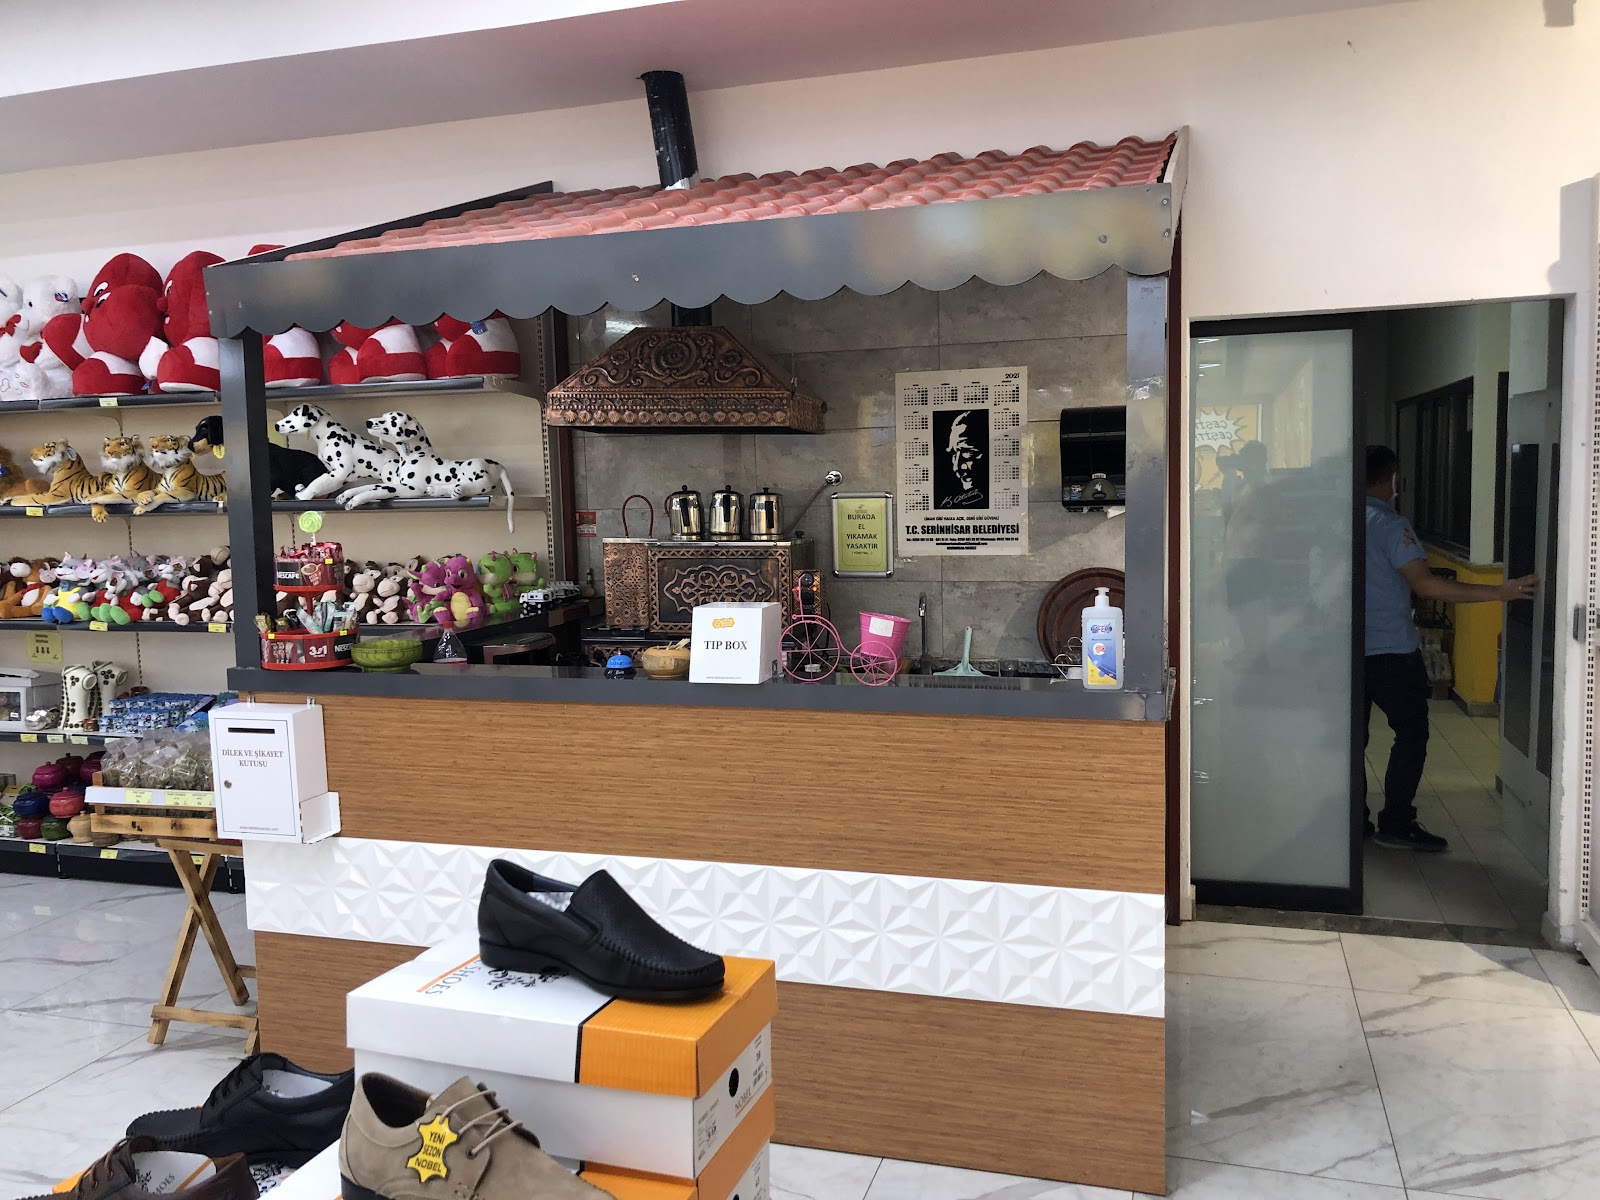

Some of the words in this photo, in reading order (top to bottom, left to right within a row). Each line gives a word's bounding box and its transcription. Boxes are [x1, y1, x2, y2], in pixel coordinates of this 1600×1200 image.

[905, 525, 919, 535] T.C.
[921, 524, 971, 535] SERİNHİSAR
[973, 523, 1019, 534] BELEDİYESİ
[704, 641, 723, 650] TIP
[725, 640, 748, 650] BOX
[222, 748, 243, 757] DİLEK
[245, 749, 254, 757] VE
[255, 749, 283, 759] ŞİKAYET
[430, 1131, 446, 1145] YENİ
[422, 1144, 442, 1159] SEZON
[414, 1157, 442, 1172] NOBEL
